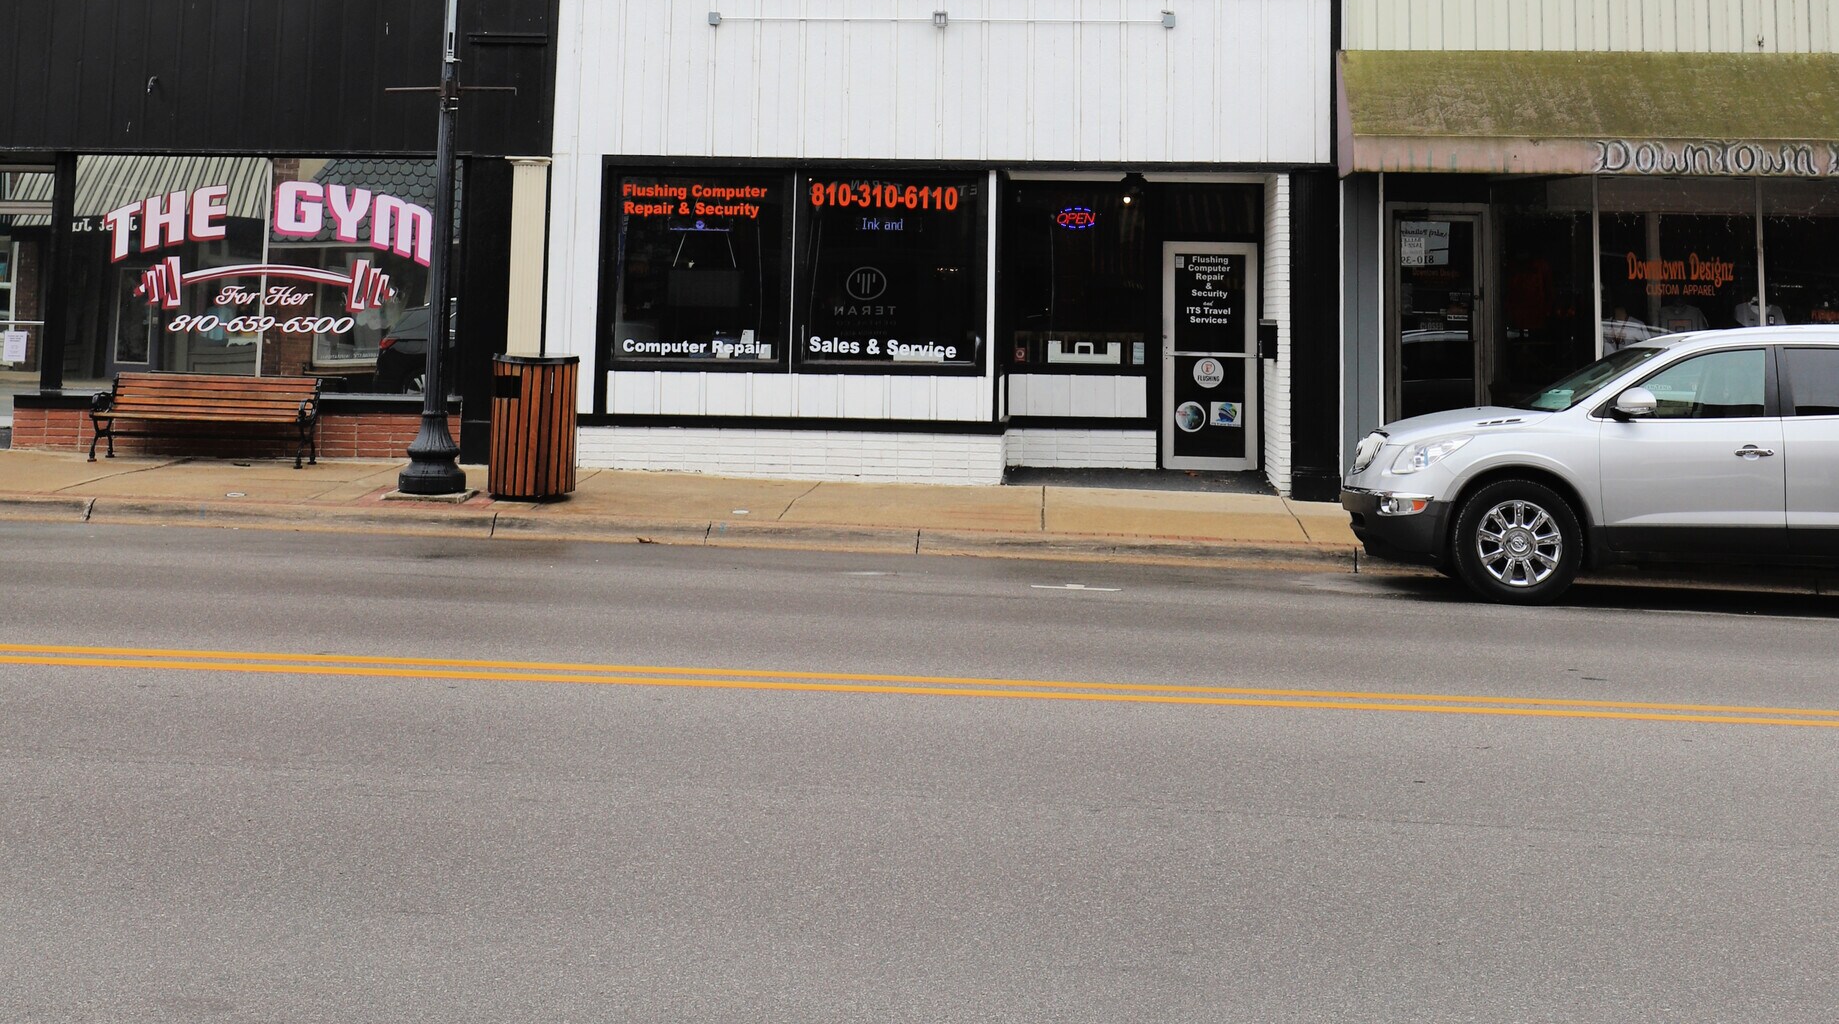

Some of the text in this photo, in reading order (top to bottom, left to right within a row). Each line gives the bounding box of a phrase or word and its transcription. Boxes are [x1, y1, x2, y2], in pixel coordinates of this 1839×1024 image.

[623, 183, 768, 200] Flushing Computer
[811, 182, 958, 210] 810-310-6110
[624, 201, 759, 218] Repair & Security
[106, 181, 433, 267] THE GYM
[862, 217, 904, 231] Ink and
[1057, 212, 1096, 225] OPEN
[1192, 256, 1229, 265] Flushing
[1188, 264, 1231, 273] Computer
[1626, 251, 1735, 288] Downtown Designz
[1195, 273, 1224, 281] Repair
[1205, 282, 1212, 290] &
[1645, 283, 1716, 297] CUSTOM APPAREL
[214, 286, 313, 307] For Her
[1191, 289, 1228, 299] Security
[1203, 307, 1231, 315] Travel
[167, 314, 354, 334] 810-659-6500
[1190, 316, 1228, 324] Services
[622, 339, 768, 356] Computer Repair
[809, 336, 957, 358] Sales & Service
